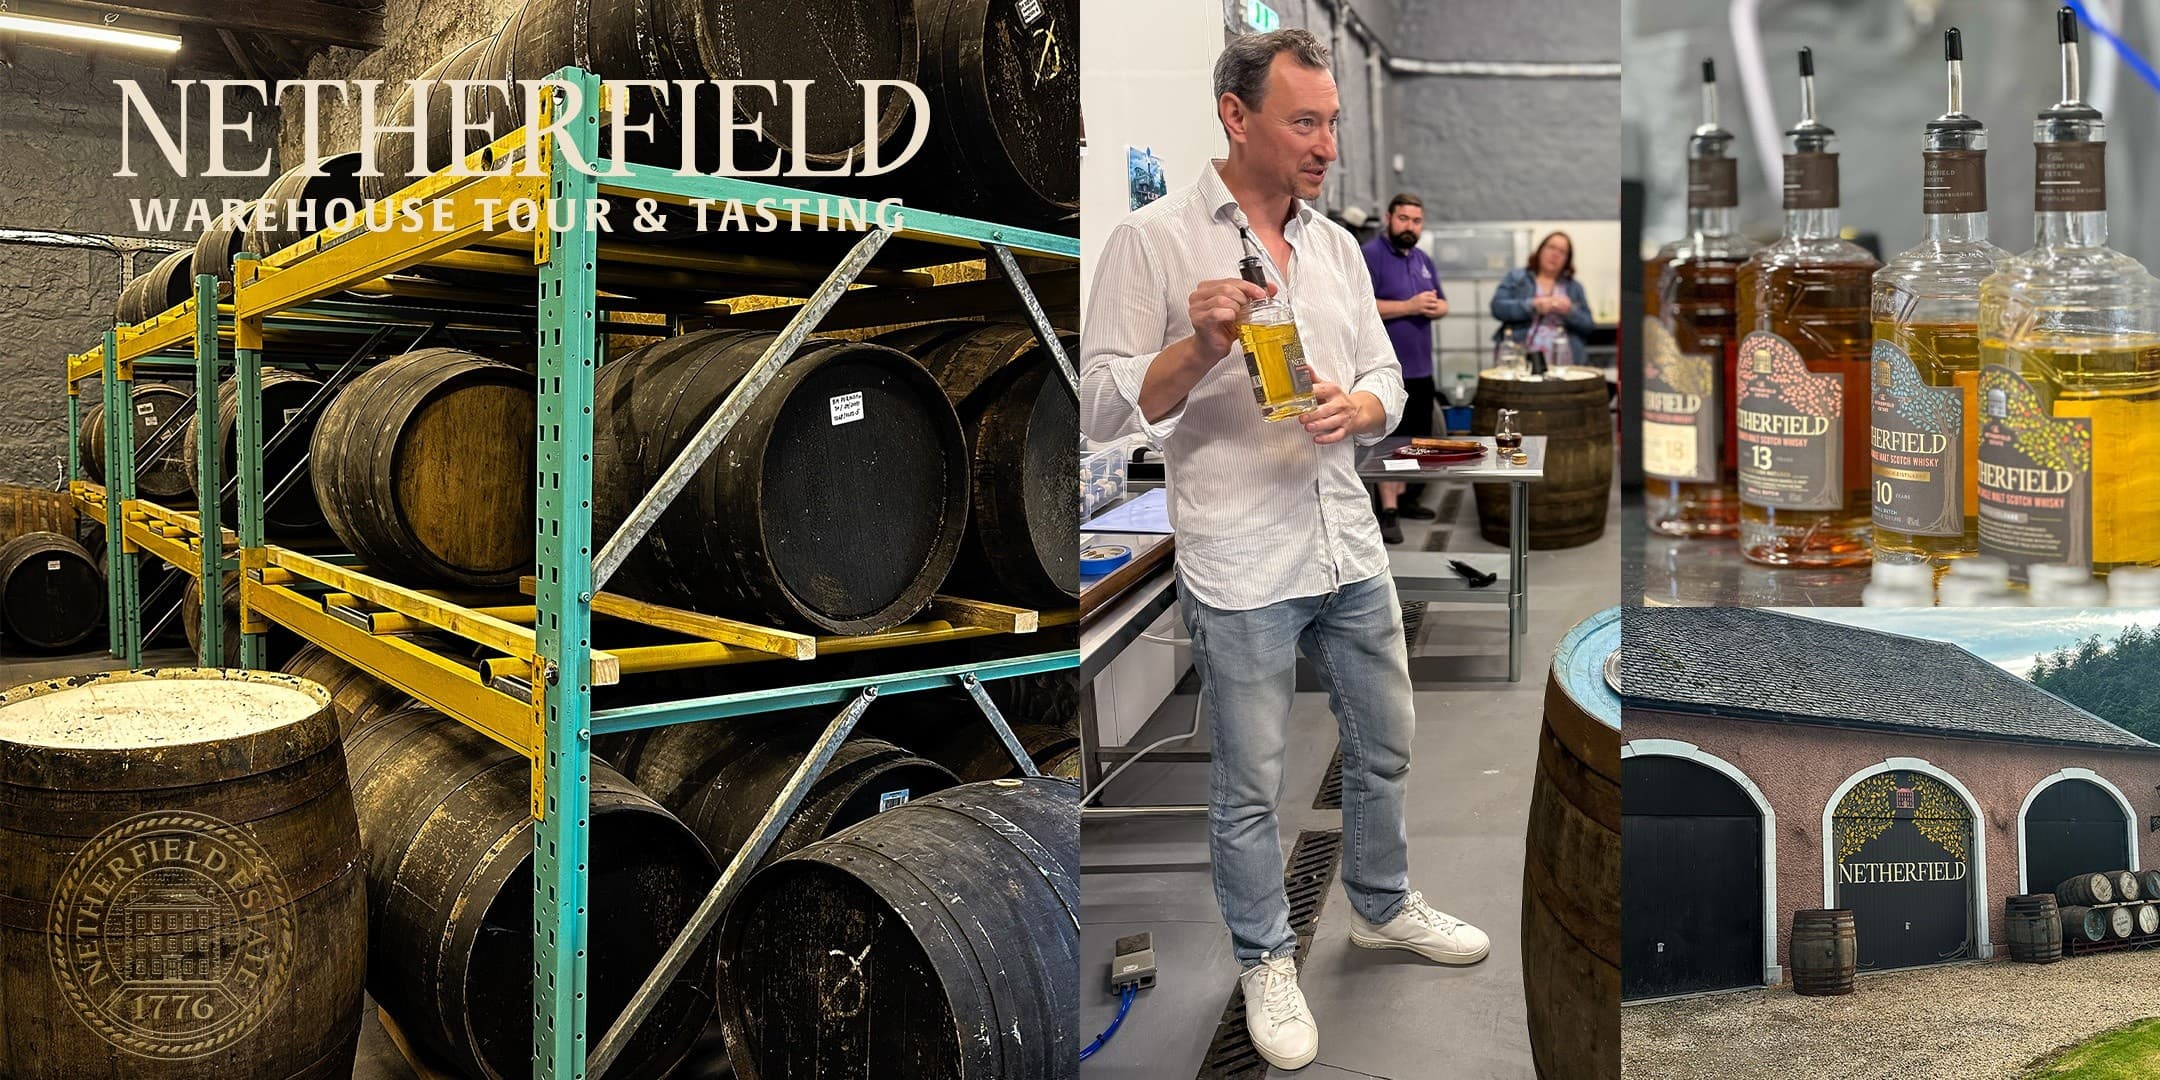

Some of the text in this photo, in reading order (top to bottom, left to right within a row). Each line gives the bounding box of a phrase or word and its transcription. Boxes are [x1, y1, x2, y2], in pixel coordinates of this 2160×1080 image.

[1752, 445, 1773, 470] 13
[1890, 454, 1911, 465] SCOTCH
[1912, 457, 1939, 468] WHISKY
[1875, 479, 1893, 505] 10
[1838, 861, 1966, 884] NETHERFIELD
